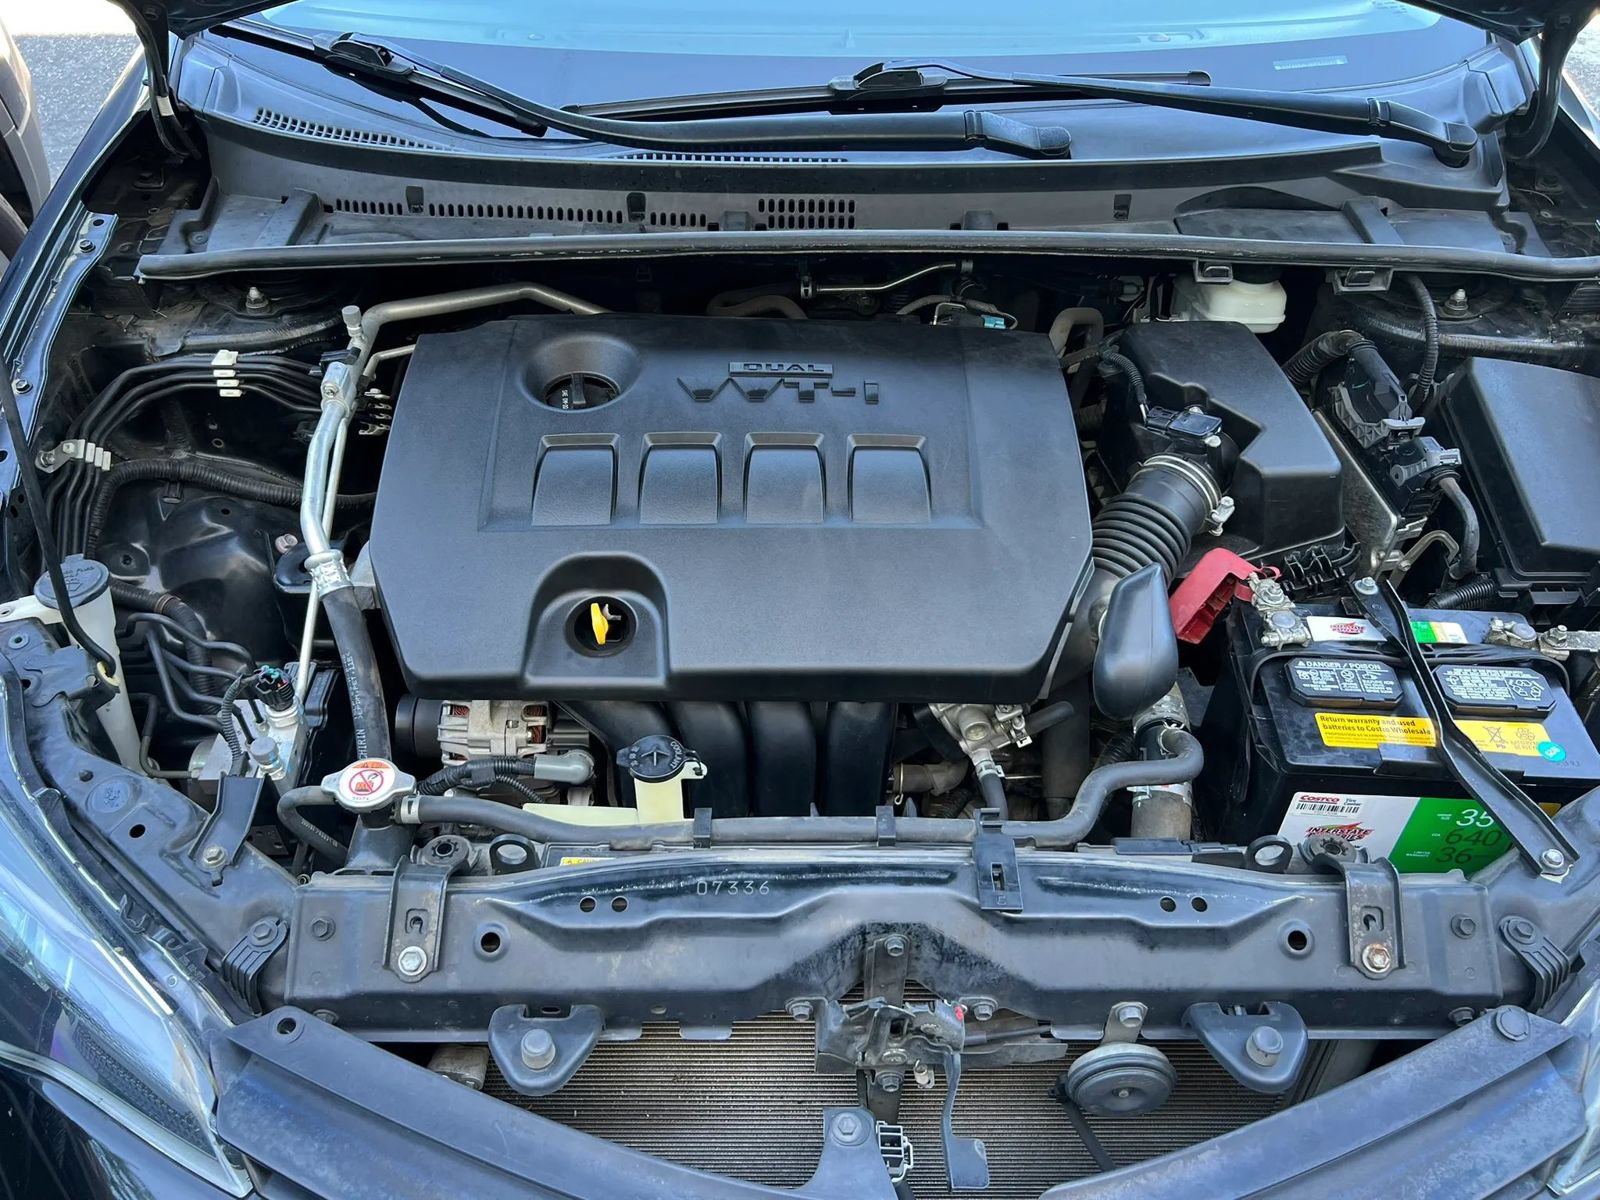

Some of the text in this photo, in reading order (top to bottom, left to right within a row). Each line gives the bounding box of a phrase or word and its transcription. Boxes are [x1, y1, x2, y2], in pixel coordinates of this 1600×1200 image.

[743, 363, 824, 373] DUAL
[1306, 661, 1340, 669] DANGER
[1350, 662, 1381, 671] POISON
[1320, 715, 1346, 723] Return
[1347, 717, 1380, 726] warranty
[1322, 723, 1356, 732] batteries
[1365, 725, 1389, 733] Costco
[1390, 727, 1431, 736] Wholesale
[1456, 809, 1494, 828] 35
[1305, 827, 1370, 836] INTERSTATE
[1445, 828, 1502, 847] 640
[1435, 847, 1473, 865] 36
[696, 880, 770, 896] 07336
